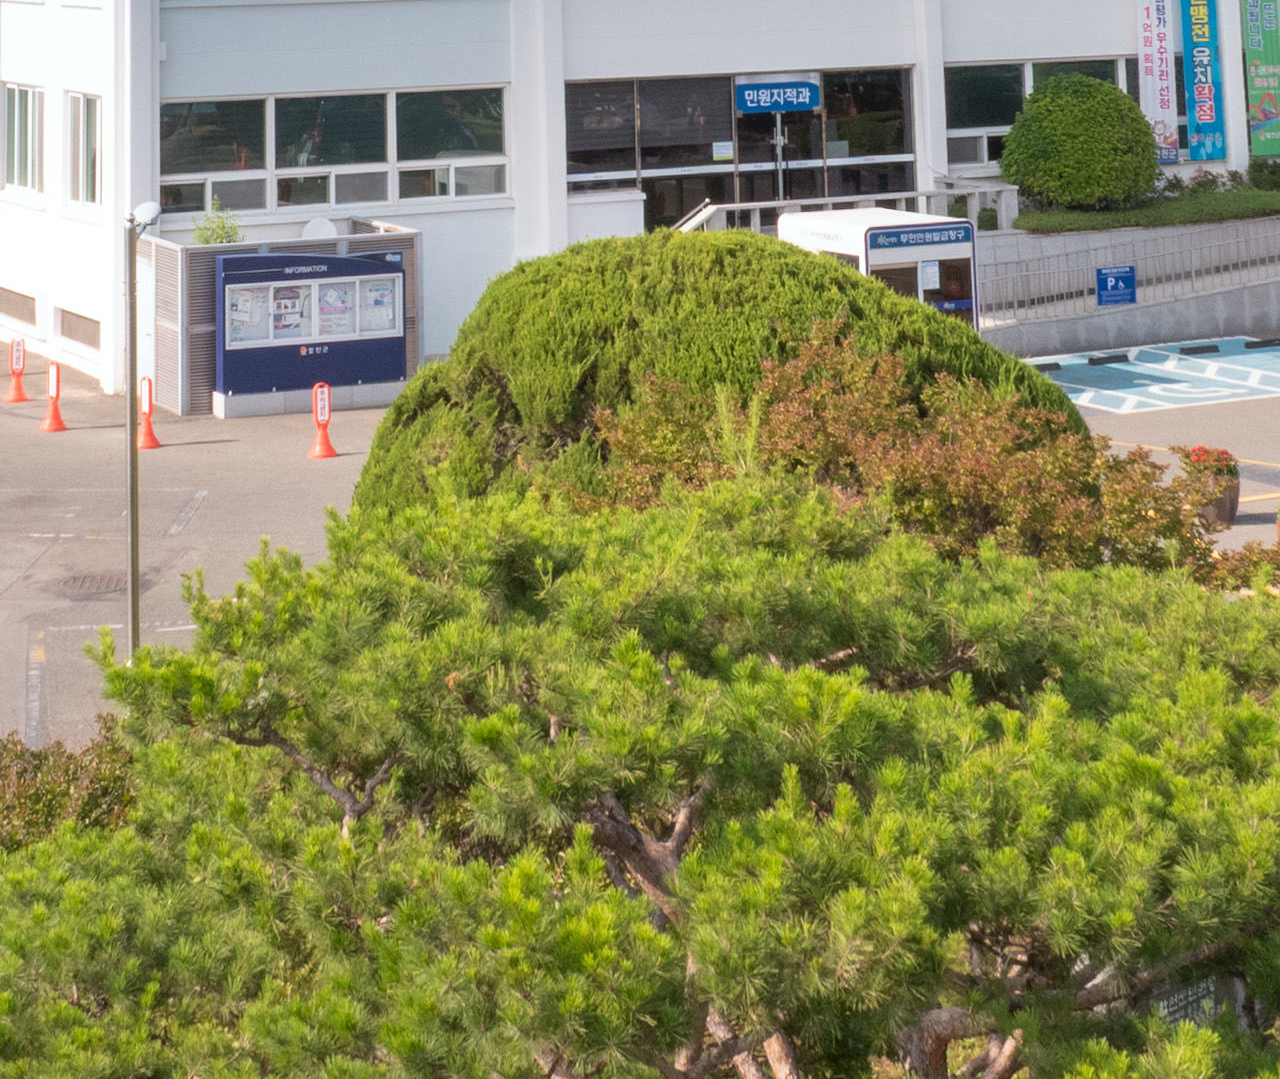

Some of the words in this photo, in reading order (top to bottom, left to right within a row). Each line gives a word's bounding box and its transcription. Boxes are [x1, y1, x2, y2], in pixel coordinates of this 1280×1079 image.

[1263, 3, 1276, 30] 또는
[1156, 32, 1169, 82] 우수기관
[744, 87, 811, 107] 민원지적과
[1159, 86, 1170, 110] 선정
[900, 230, 965, 243] 무인민원발급창구
[285, 265, 327, 274] INFORMATION
[1107, 277, 1116, 290] P
